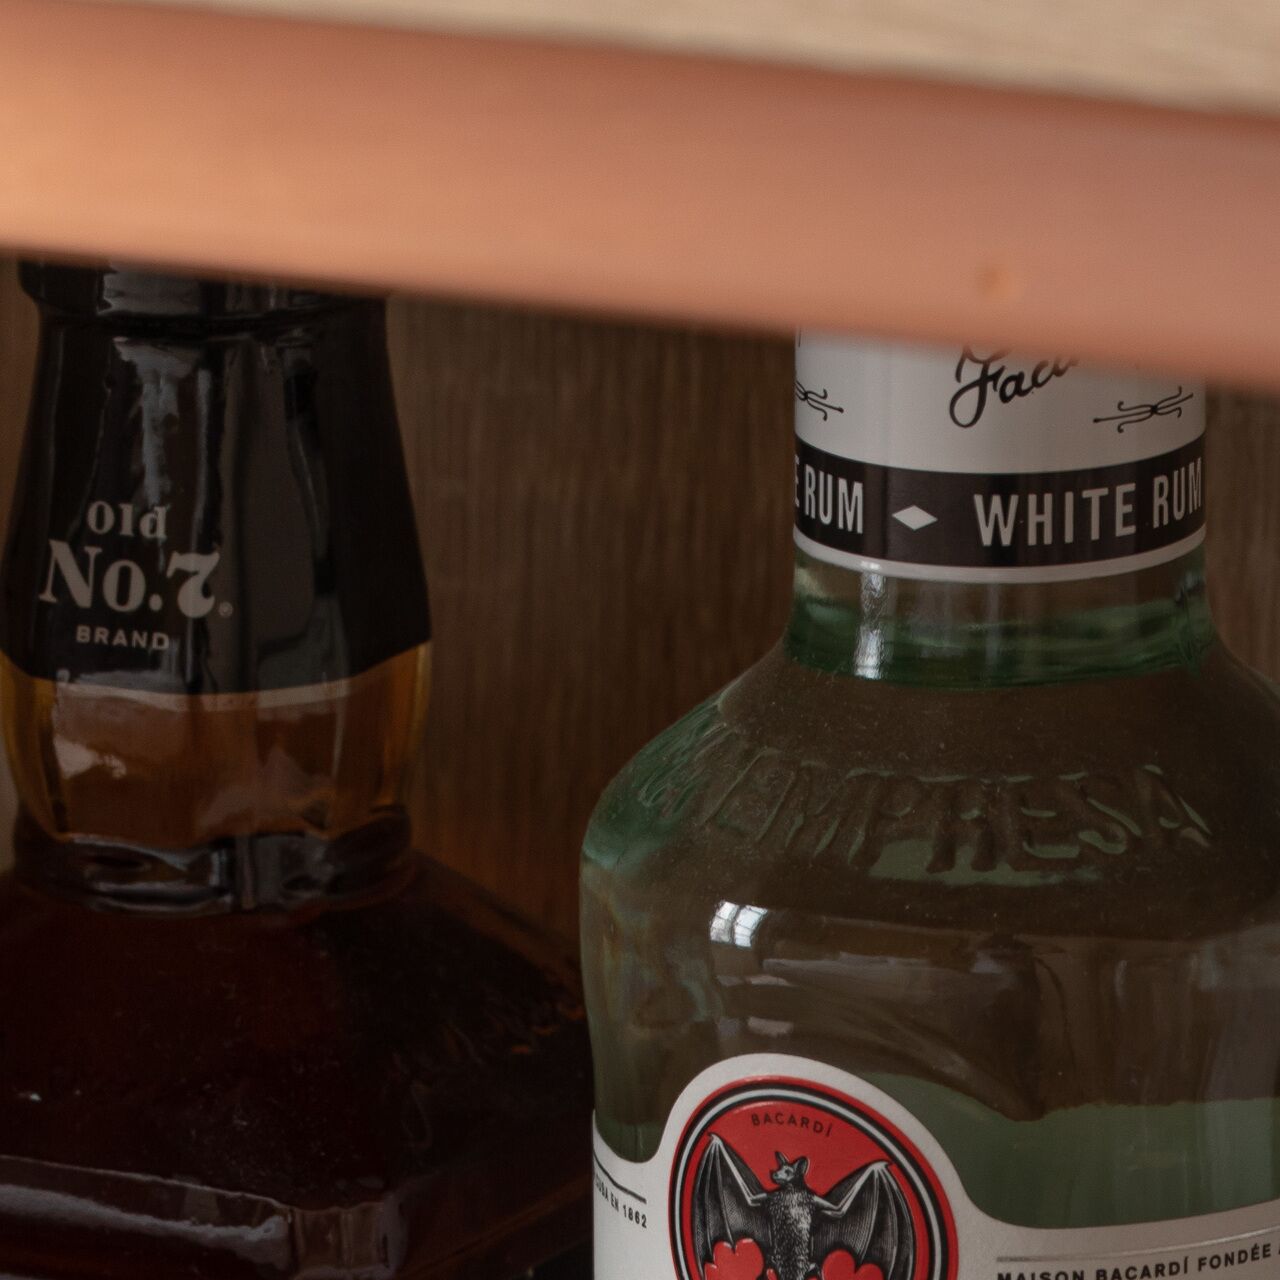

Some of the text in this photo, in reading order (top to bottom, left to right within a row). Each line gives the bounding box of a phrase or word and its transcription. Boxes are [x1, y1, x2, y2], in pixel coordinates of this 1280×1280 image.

[804, 470, 864, 534] RUM
[973, 456, 1202, 547] WHITE RUM
[76, 625, 170, 650] BRAND
[751, 1112, 833, 1137] BACARDÍ
[623, 1204, 647, 1229] 1862
[1198, 1243, 1272, 1272] FONDÉE
